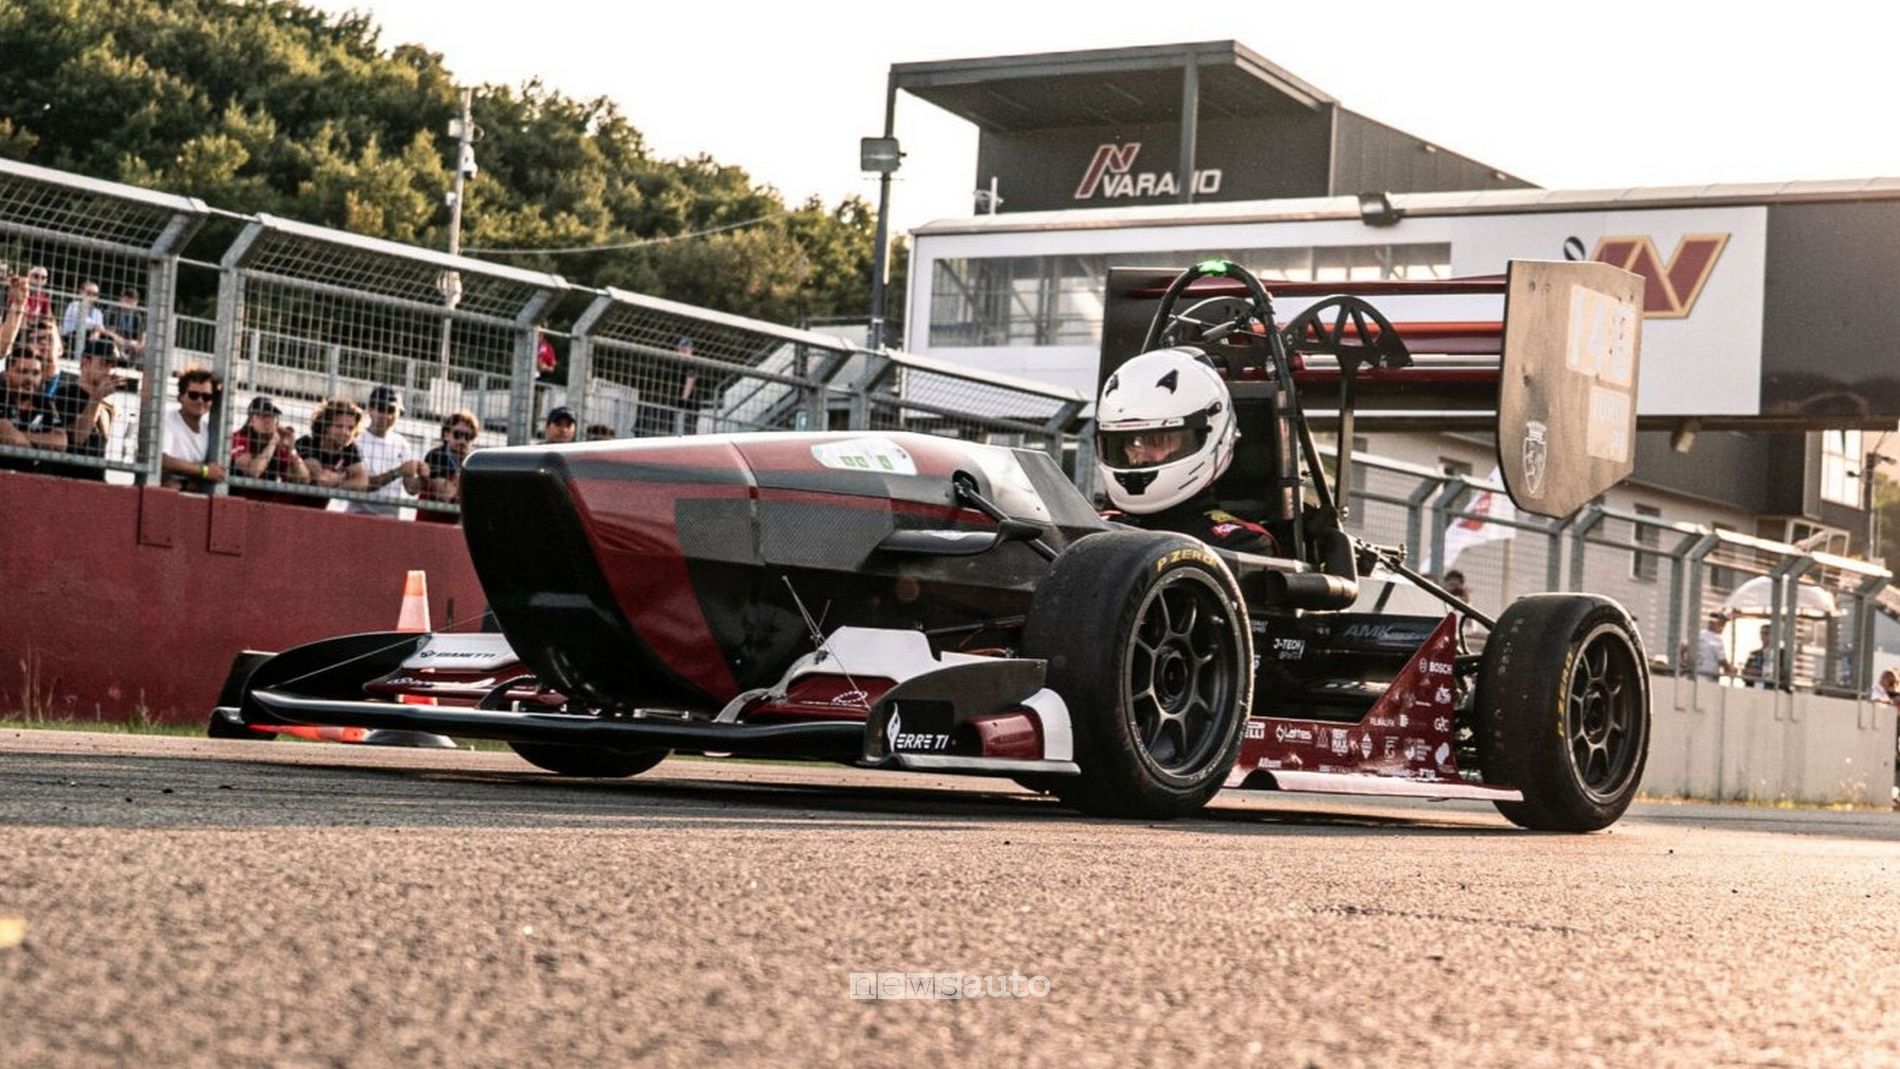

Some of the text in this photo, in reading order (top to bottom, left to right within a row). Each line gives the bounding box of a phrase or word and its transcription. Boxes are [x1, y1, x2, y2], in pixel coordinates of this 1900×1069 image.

[1429, 661, 1453, 674] BOSCH
[897, 733, 950, 750] ERRE TI
